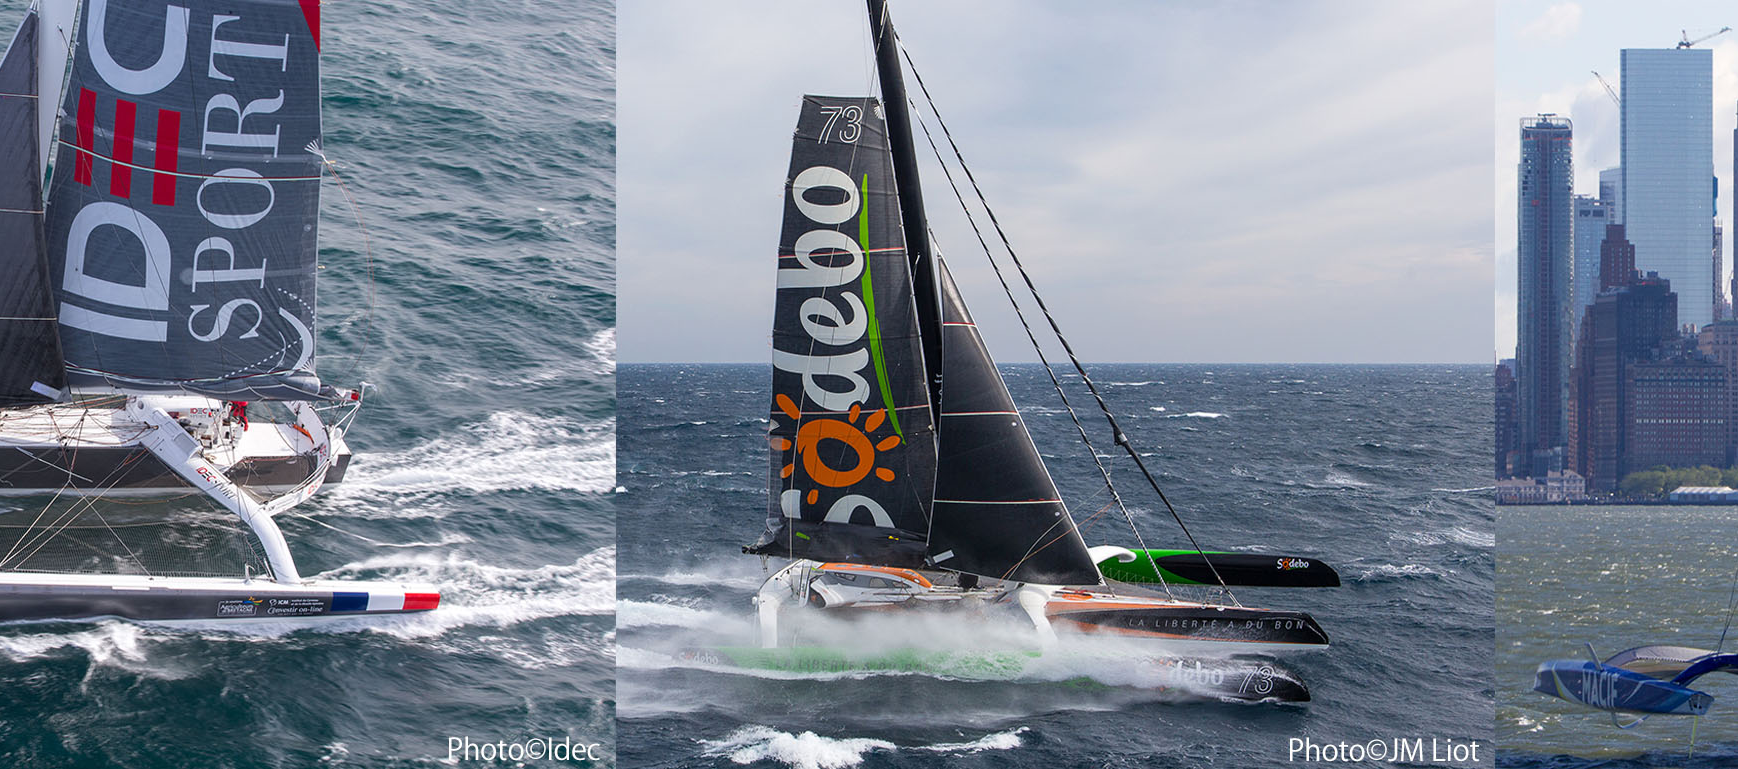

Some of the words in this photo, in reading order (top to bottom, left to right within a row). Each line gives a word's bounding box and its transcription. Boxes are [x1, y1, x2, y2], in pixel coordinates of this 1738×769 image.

[817, 105, 863, 145] 73
[59, 0, 191, 343] IDEC
[188, 14, 290, 343] SPORT
[1276, 558, 1310, 570] Sodebo
[1129, 618, 1145, 627] LA
[1245, 619, 1264, 630] DU
[1274, 619, 1305, 630] BON
[1238, 665, 1276, 695] 73
[1581, 669, 1620, 709] MACIF
